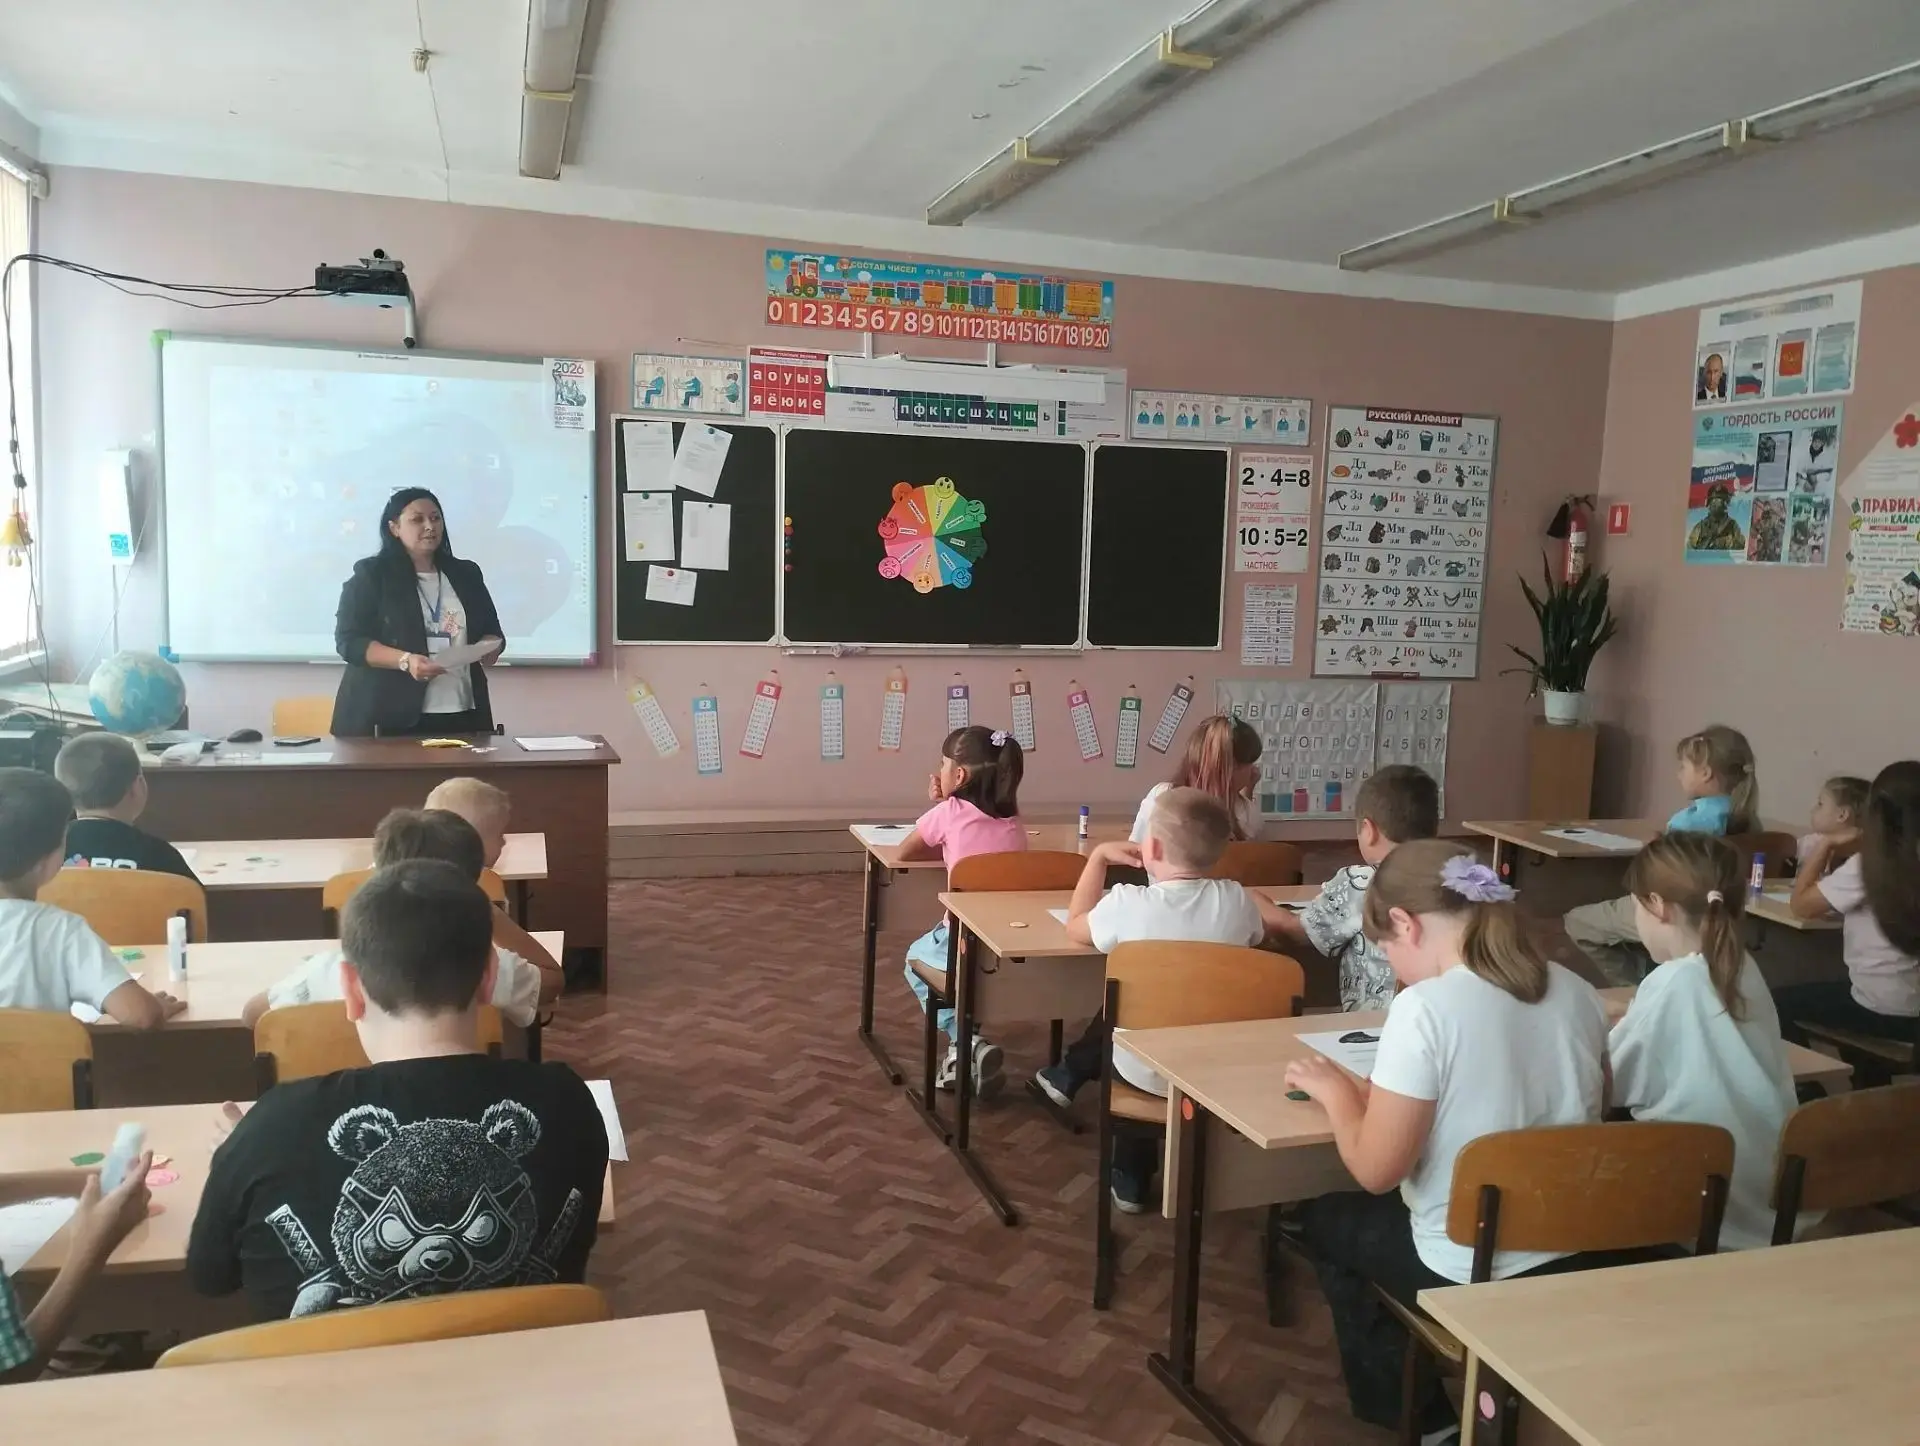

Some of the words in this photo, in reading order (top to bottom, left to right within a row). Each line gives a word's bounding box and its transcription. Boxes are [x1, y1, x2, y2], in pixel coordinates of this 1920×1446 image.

[850, 261, 885, 271] СОСТАВ
[888, 264, 917, 274] ЧИСЕЛ
[768, 301, 783, 321] 0
[789, 302, 798, 323] 1
[803, 303, 817, 325] 2
[820, 304, 834, 326] 3
[837, 306, 851, 328] 4
[854, 307, 868, 329] 5
[870, 309, 885, 331] 6
[888, 311, 901, 331] 7
[903, 312, 918, 333] 8
[921, 313, 935, 333] 9
[936, 315, 950, 335] 10
[953, 316, 967, 337] 11
[969, 318, 984, 338] 12
[985, 319, 1000, 339] 13
[1001, 320, 1016, 341] 14
[1017, 322, 1032, 342] 15
[1033, 323, 1047, 343] 16
[1050, 324, 1064, 345] 17
[1064, 325, 1079, 346] 18
[1080, 327, 1094, 347] 19
[1094, 328, 1110, 348] 20
[554, 362, 584, 375] 2026
[753, 370, 762, 380] а
[768, 371, 777, 381] о
[784, 373, 793, 385] у
[797, 374, 809, 384] ы
[813, 375, 822, 385] э
[753, 395, 762, 405] я
[767, 393, 777, 406] ё
[781, 398, 793, 407] ю
[798, 399, 807, 408] и
[812, 399, 822, 409] е
[901, 405, 909, 414] п
[913, 403, 925, 417] ф
[929, 407, 938, 416] к
[944, 408, 952, 417] т
[957, 408, 966, 417] с
[970, 408, 981, 418] ш
[985, 409, 994, 419] х
[999, 409, 1008, 421] ц
[1013, 410, 1021, 420] ч
[1025, 411, 1037, 422] щ
[1043, 413, 1050, 421] ь
[1368, 410, 1411, 421] РУССКИЙ
[1414, 414, 1462, 424] АЛФАВИТ
[1722, 413, 1781, 428] ГОРДОСТЬ
[1784, 406, 1836, 422] РОССИИ
[1354, 426, 1369, 437] Аа
[1396, 429, 1410, 440] Бб
[1437, 432, 1451, 442] Вв
[1477, 435, 1489, 445] Гг
[1351, 458, 1366, 470] Дд
[1394, 460, 1407, 471] Ее
[1435, 460, 1448, 473] Ёё
[1468, 465, 1489, 476] Жж
[1704, 464, 1734, 475] ВОЕННАЯ
[1242, 468, 1254, 485] 2
[1350, 489, 1363, 500] Зз
[1390, 492, 1406, 503] Ии
[1433, 492, 1448, 504] Йй
[1471, 496, 1485, 507] Кк
[1862, 497, 1920, 513] ПРАВИЛ
[1239, 528, 1259, 545] 10
[1346, 521, 1362, 532] Лл
[1387, 523, 1405, 533] Мм
[1430, 525, 1445, 536] Нн
[1469, 527, 1483, 537] Оо
[1245, 561, 1278, 570] ЧАСТНОЕ
[1344, 552, 1360, 562] Пп
[1387, 554, 1401, 566] Рр
[1428, 555, 1441, 566] Сс
[1468, 557, 1481, 567] Тт
[1342, 583, 1356, 596] Уу
[1382, 585, 1401, 597] Фф
[1424, 586, 1440, 597] Хх
[1462, 588, 1477, 599] Цц
[1340, 615, 1355, 625] Чч
[1376, 616, 1398, 625] Шш
[1420, 617, 1440, 628] Щщ
[1458, 618, 1476, 628] Ыы
[1369, 646, 1382, 656] Ээ
[1403, 647, 1424, 657] Юю
[1448, 648, 1463, 658] Яя
[1250, 705, 1259, 717] В
[1301, 707, 1310, 717] е
[1386, 709, 1393, 721] 0
[1404, 710, 1409, 721] 1
[1420, 709, 1428, 720] 2
[1436, 708, 1443, 720] 3
[1383, 739, 1390, 748] 4
[1401, 738, 1409, 750] 5
[1418, 738, 1425, 749] 6
[1435, 737, 1441, 750] 7
